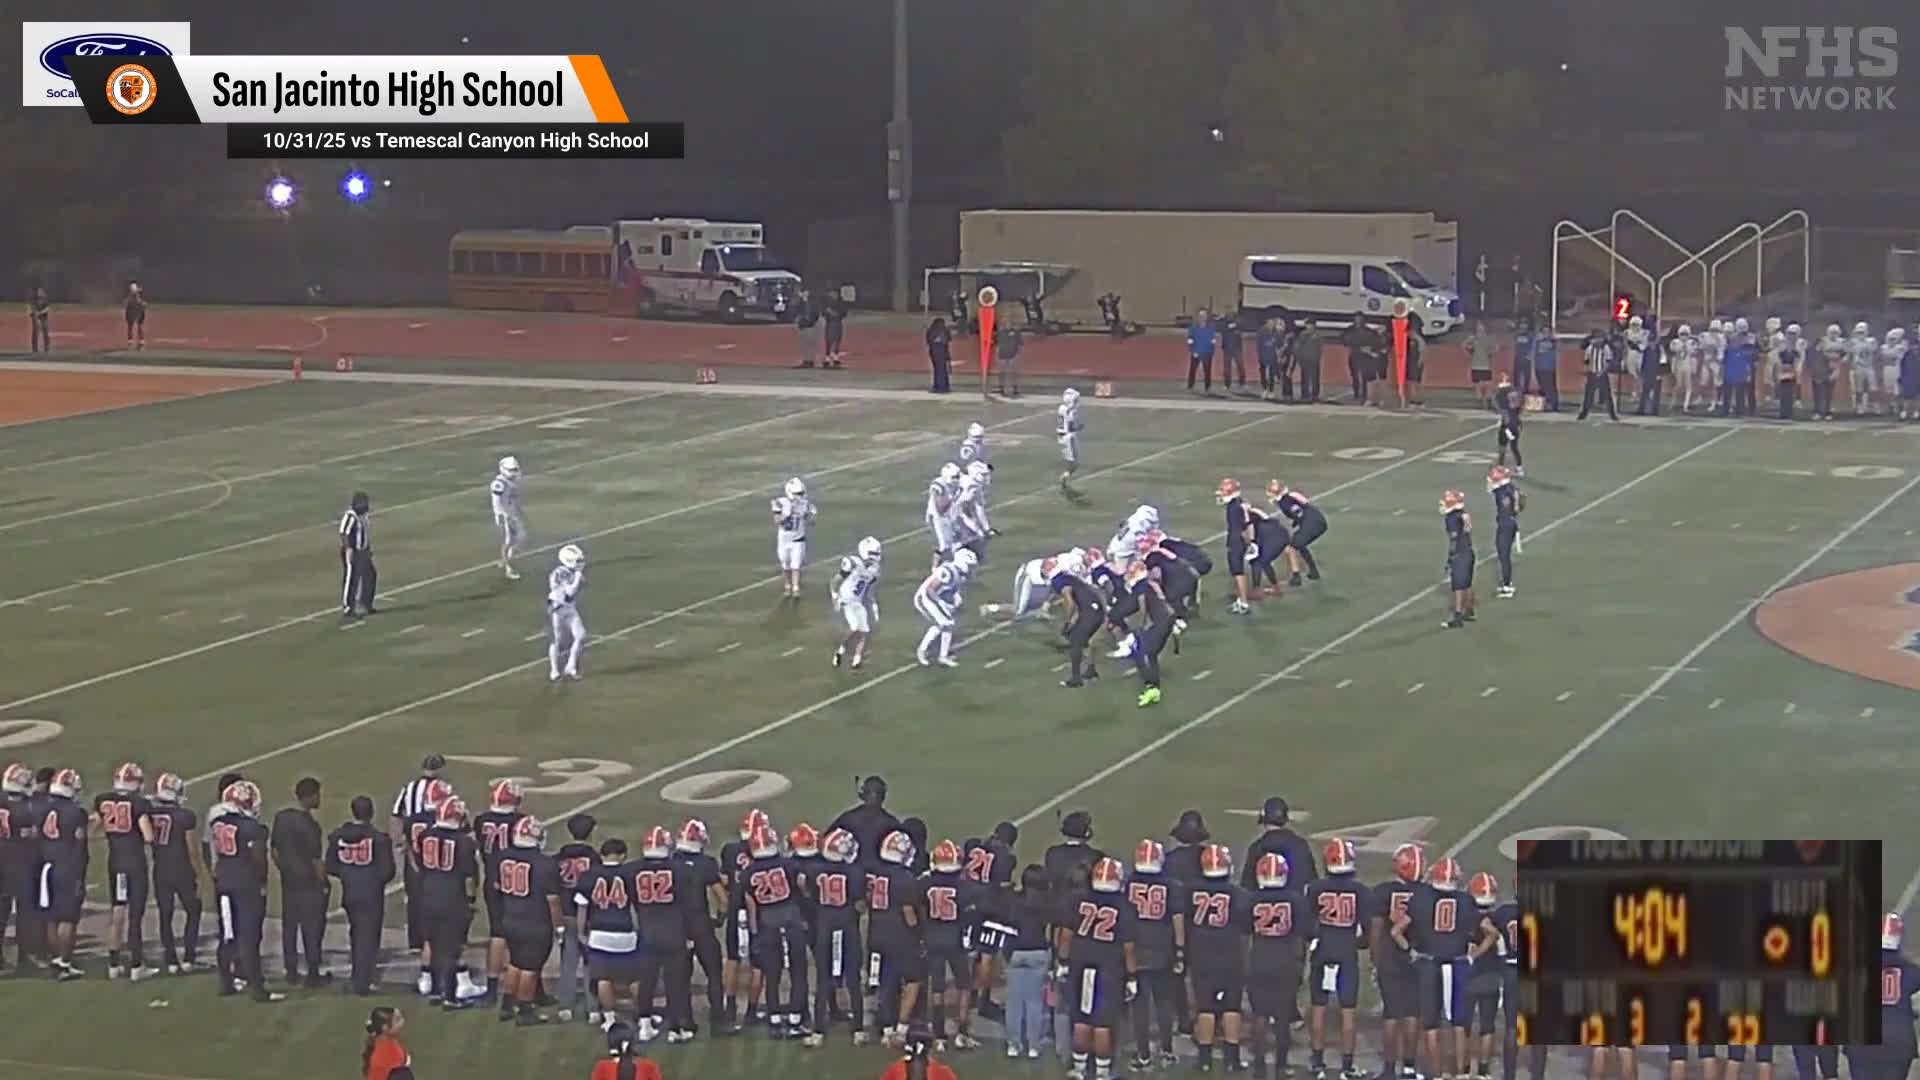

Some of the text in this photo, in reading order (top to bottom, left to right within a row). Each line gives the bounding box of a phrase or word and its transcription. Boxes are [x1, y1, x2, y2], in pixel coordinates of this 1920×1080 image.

[1615, 298, 1631, 320] 2
[591, 876, 628, 910] 44
[1128, 882, 1167, 920] 58
[1193, 892, 1230, 927] 73
[1318, 891, 1356, 927] 20
[1078, 902, 1119, 941] 72
[1253, 902, 1292, 937] 23
[1434, 898, 1457, 932] 0
[1613, 889, 1687, 963] 4:04
